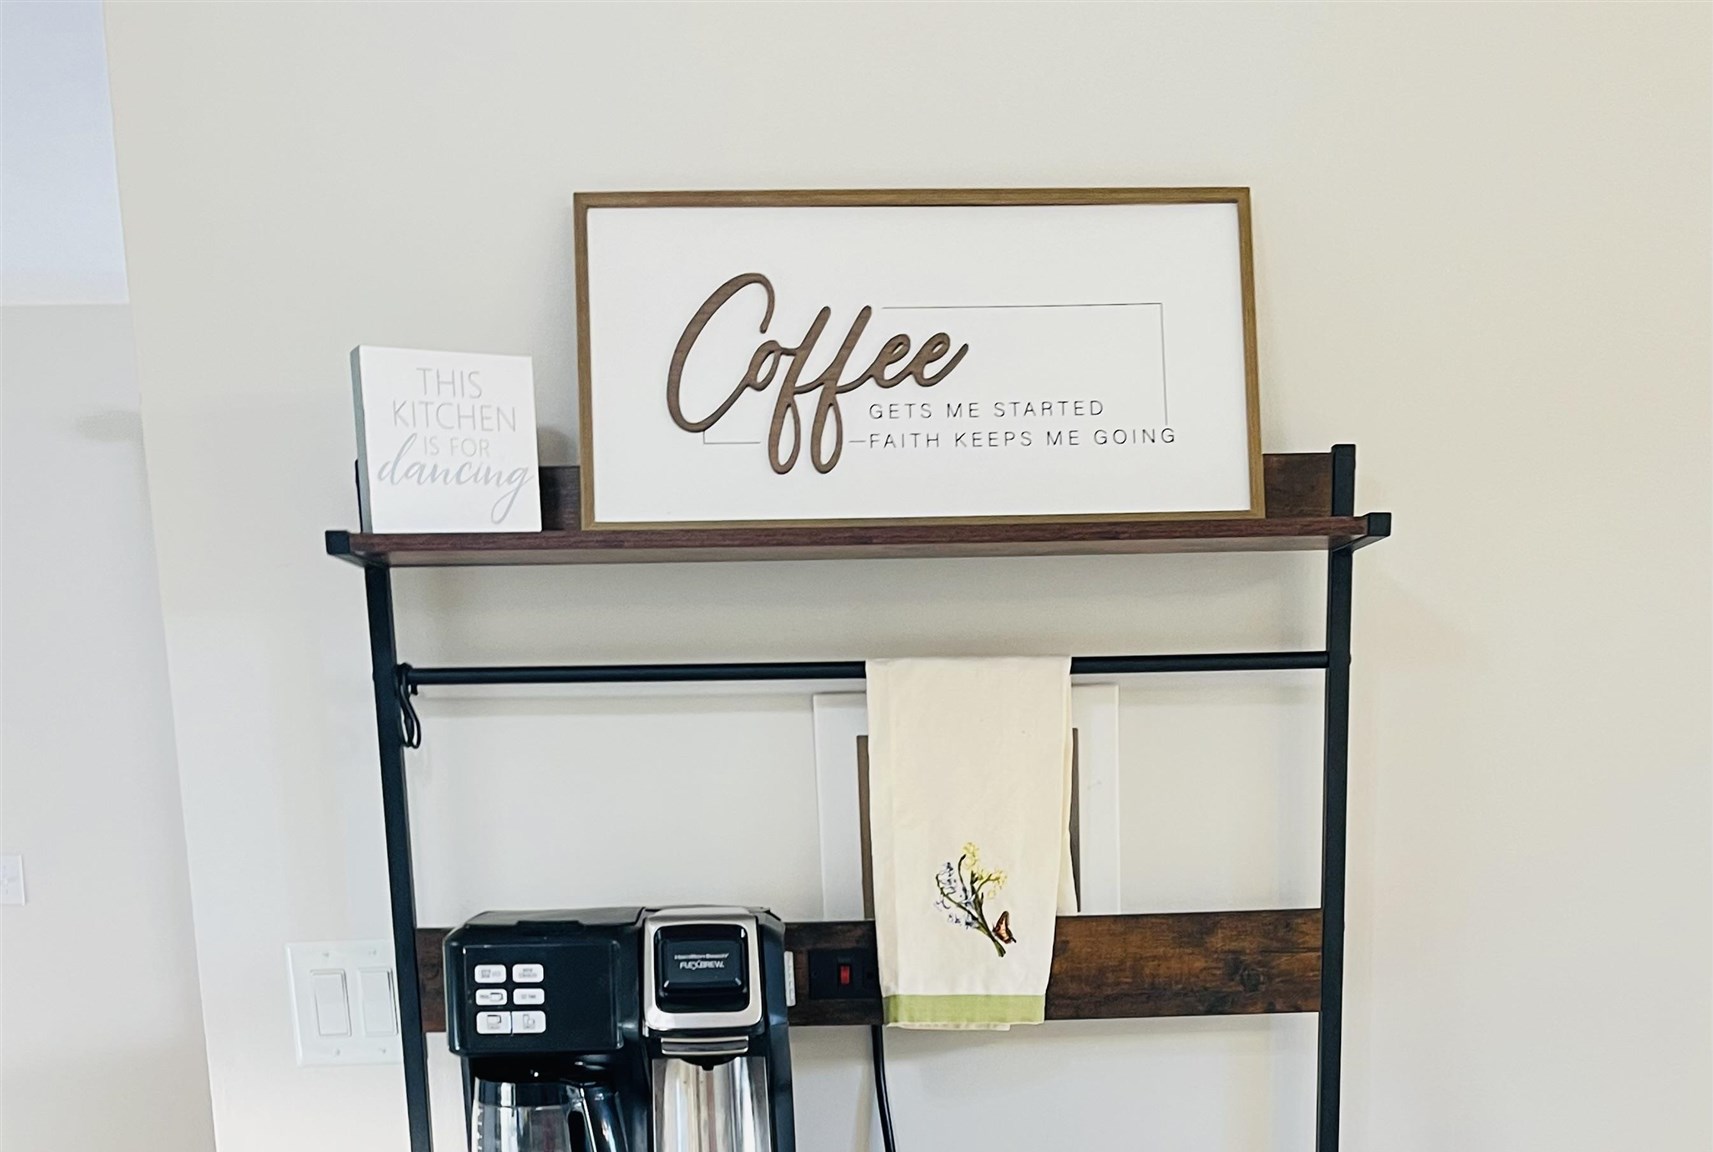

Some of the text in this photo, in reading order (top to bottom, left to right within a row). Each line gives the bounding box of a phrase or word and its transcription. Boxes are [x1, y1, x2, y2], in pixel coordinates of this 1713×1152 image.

[416, 367, 483, 399] THIS
[666, 272, 969, 475] Coffee
[393, 400, 516, 432] KITCHEN
[869, 400, 1104, 420] GETS ME STARTED
[423, 435, 491, 458] IS FOR
[869, 427, 1176, 449] FAITH KEEPS ME GOING
[377, 432, 534, 525] dancing
